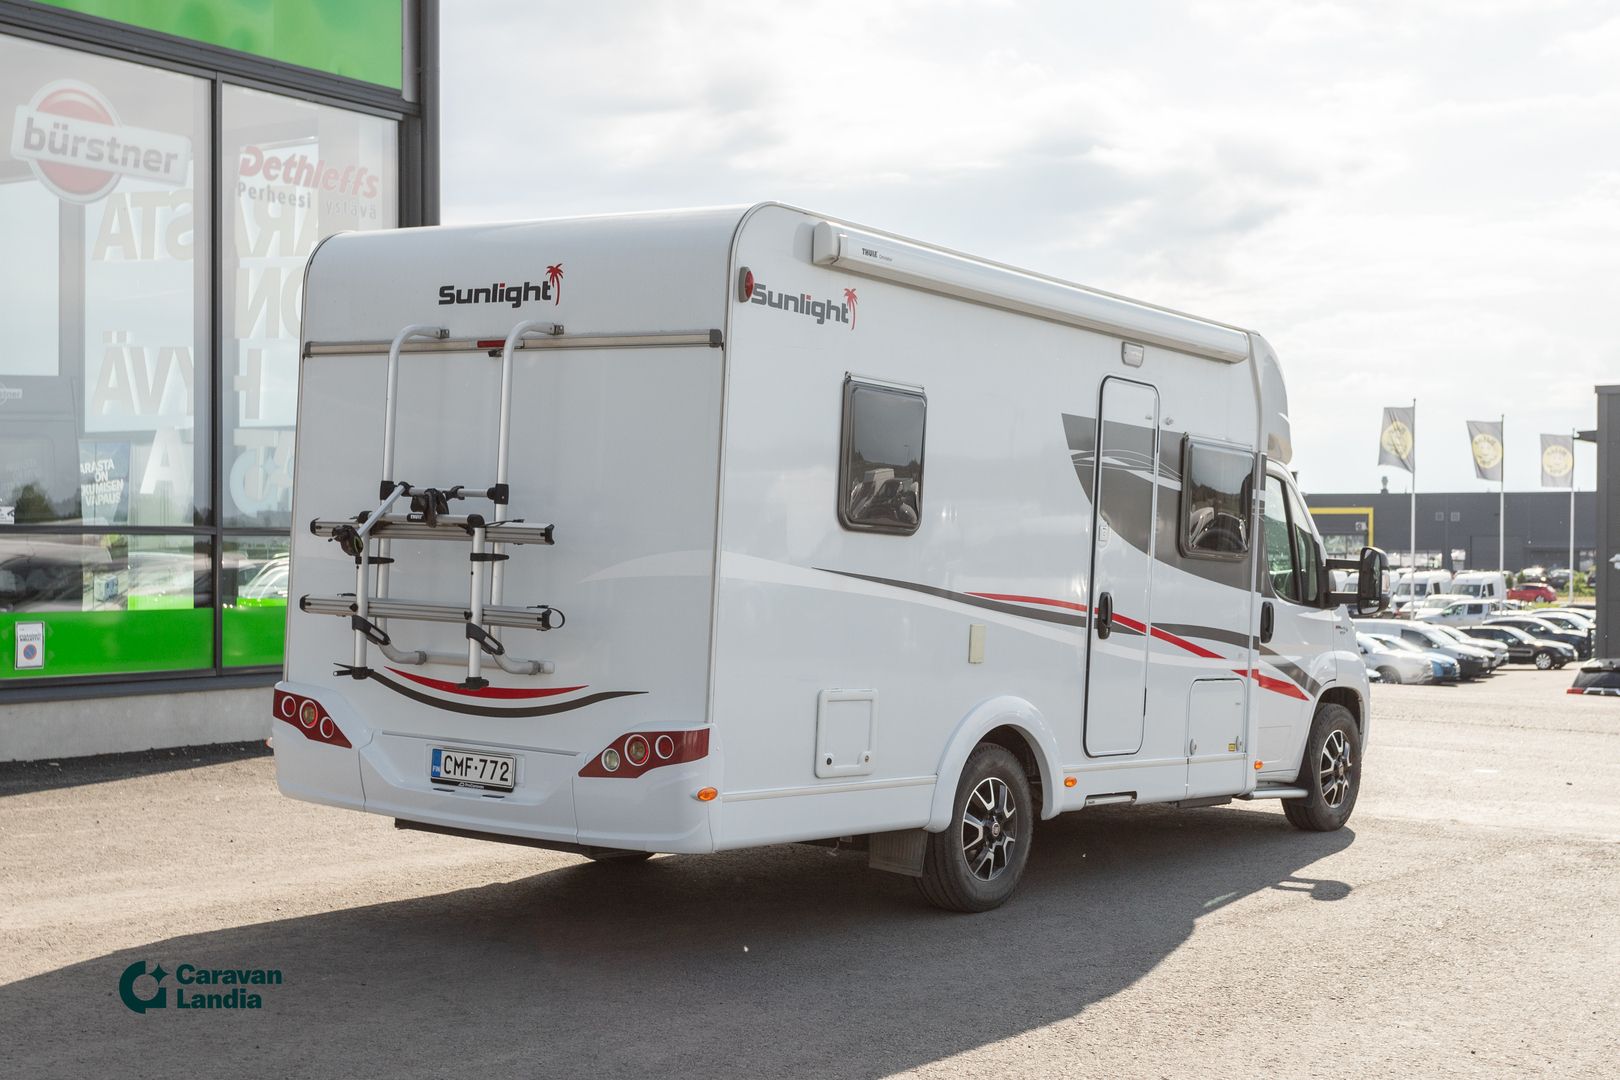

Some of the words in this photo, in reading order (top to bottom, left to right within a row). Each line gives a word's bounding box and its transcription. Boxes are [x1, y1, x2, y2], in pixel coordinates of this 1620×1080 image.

[23, 117, 179, 175] bürstner
[239, 145, 379, 199] Dethleffs
[237, 181, 312, 209] Perheesi
[438, 280, 552, 309] Sunlight
[751, 282, 849, 325] Sunlight
[95, 470, 109, 483] ON
[443, 755, 509, 782] CMF-772
